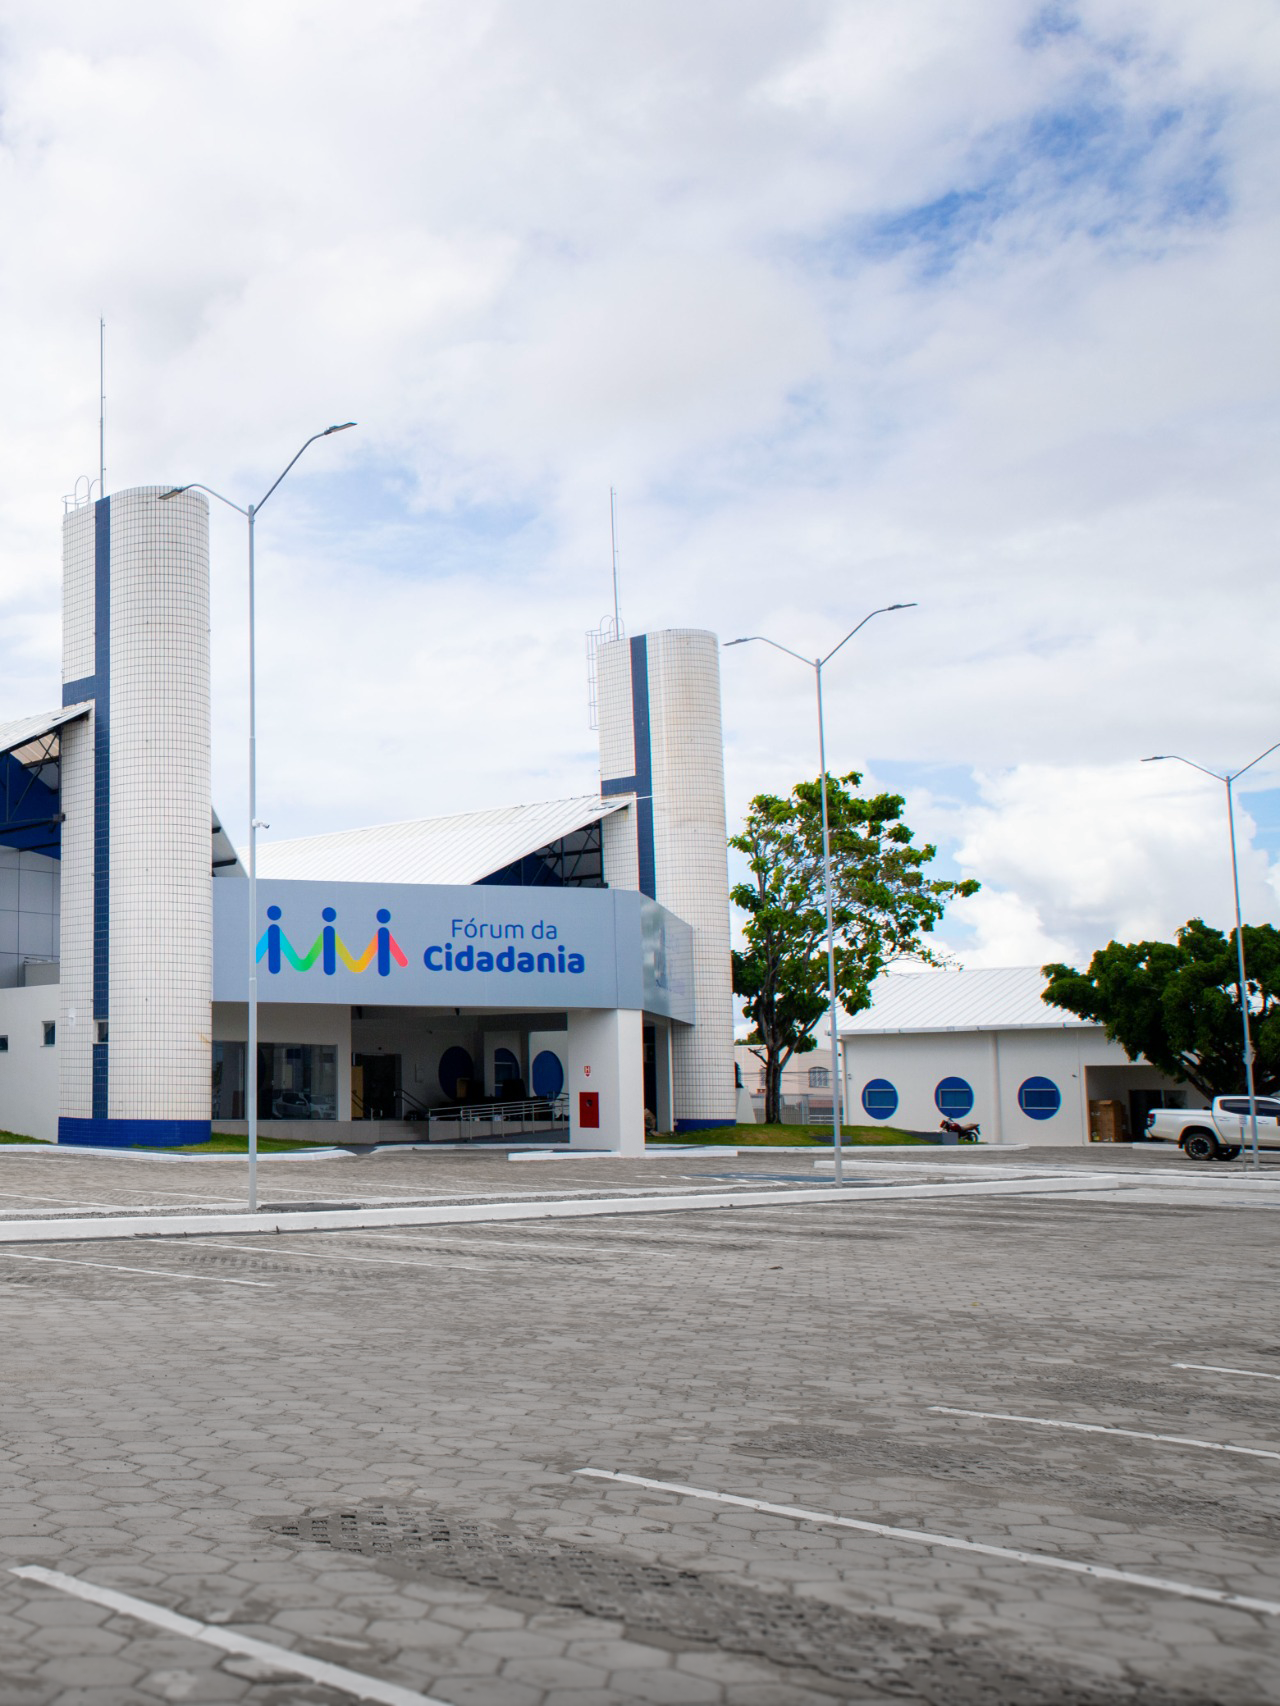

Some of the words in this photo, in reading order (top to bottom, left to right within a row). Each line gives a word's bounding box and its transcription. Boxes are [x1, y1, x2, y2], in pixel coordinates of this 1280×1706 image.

[451, 917, 525, 939] Fórum
[531, 919, 558, 940] da
[423, 942, 586, 974] Cidadania
